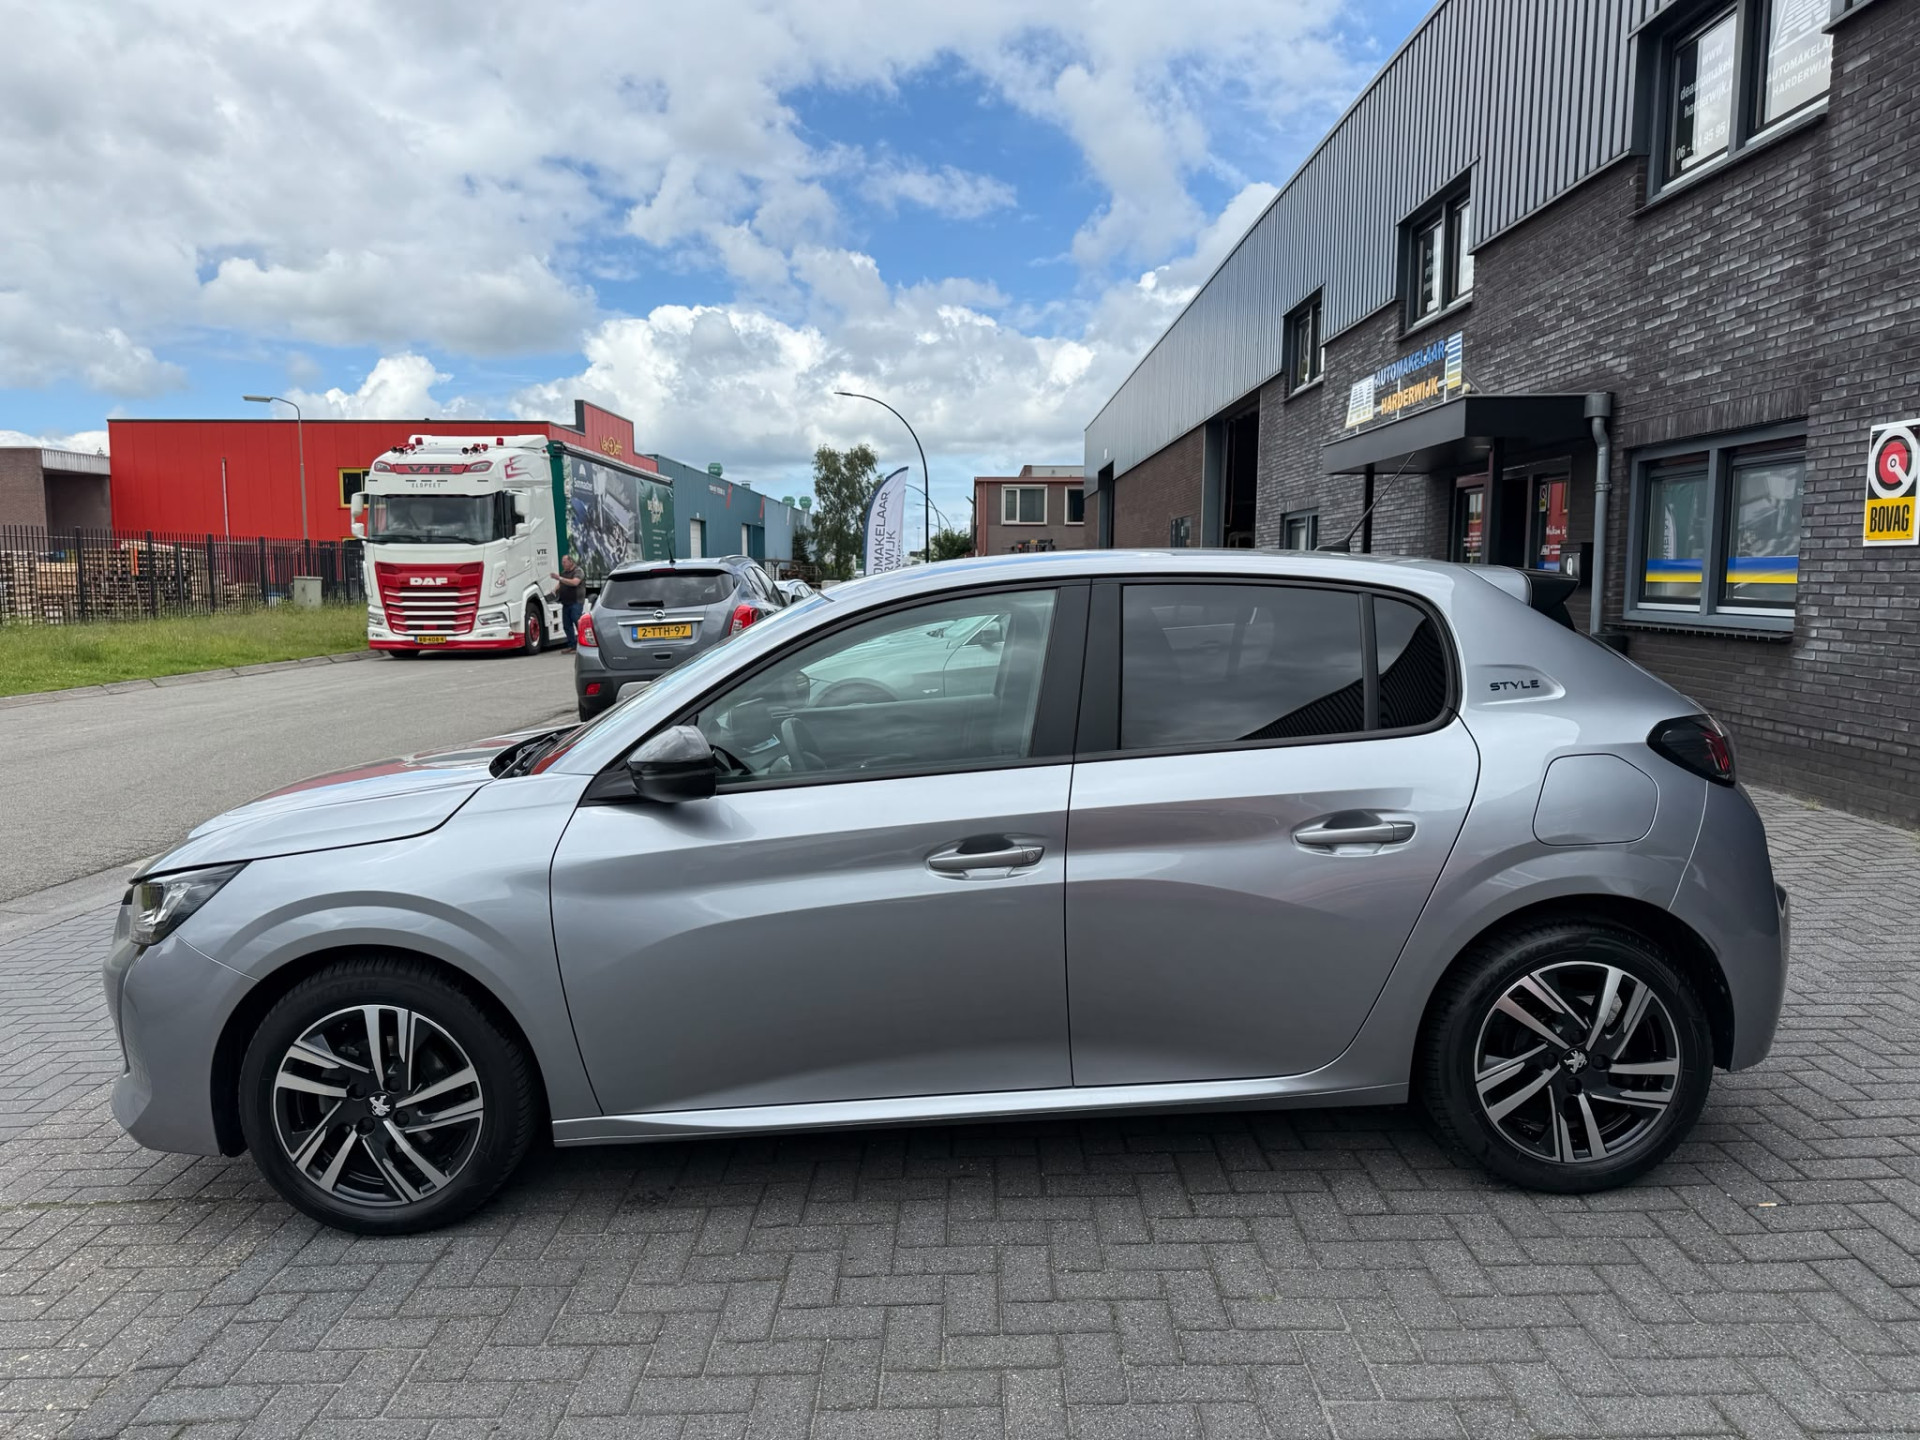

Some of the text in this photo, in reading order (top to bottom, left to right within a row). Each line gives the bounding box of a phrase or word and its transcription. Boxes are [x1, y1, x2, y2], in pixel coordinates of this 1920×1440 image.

[1375, 340, 1445, 388] AUTOMAKELAAR
[1381, 376, 1438, 415] HARDERWIJK
[1869, 504, 1910, 533] BOVAG
[409, 577, 448, 586] DAF
[641, 625, 687, 638] 2-TTH-97
[1489, 679, 1541, 692] STYLE
